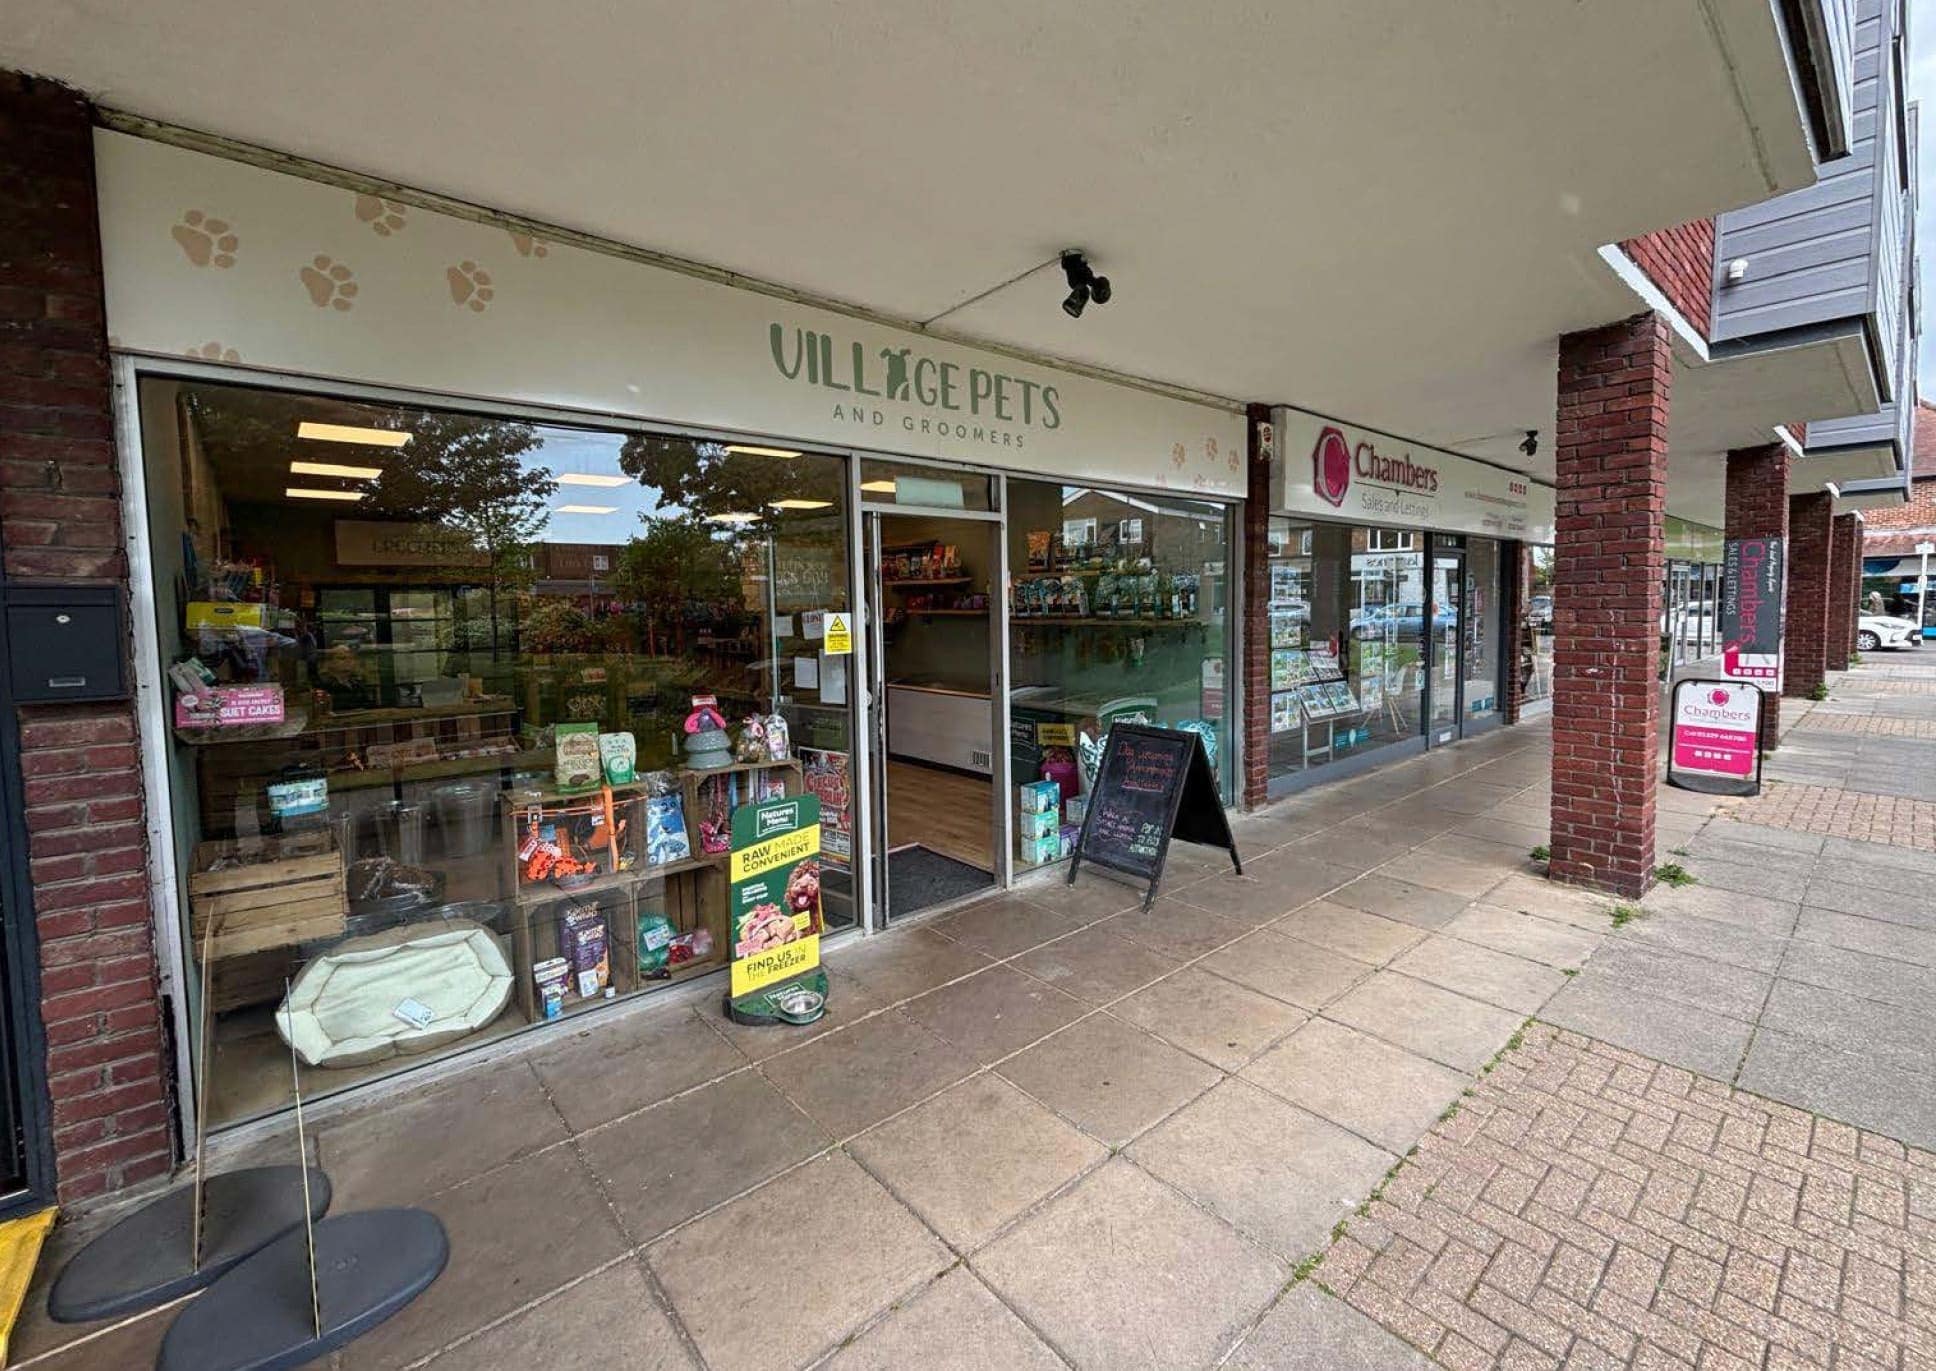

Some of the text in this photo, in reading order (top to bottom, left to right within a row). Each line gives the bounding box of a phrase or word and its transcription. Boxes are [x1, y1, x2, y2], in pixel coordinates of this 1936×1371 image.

[969, 368, 1061, 430] PETS
[832, 403, 1025, 449] AND GROOMERS
[1355, 442, 1439, 493] Chambers
[1361, 493, 1383, 512] Sales
[1384, 499, 1399, 514] and
[1727, 542, 1739, 567] SALES
[1726, 575, 1737, 616] LETTINGS
[1739, 541, 1766, 643] Chambers
[221, 705, 247, 718] SUET
[248, 704, 281, 716] CAKES
[1683, 704, 1752, 721] Chambers
[761, 807, 795, 821] Natures
[742, 844, 771, 864] RAW
[774, 831, 810, 850] MADE
[743, 841, 810, 873] CONVENIENT
[747, 956, 775, 974] FIND
[777, 949, 793, 962] US
[768, 954, 807, 974] FREEZER
